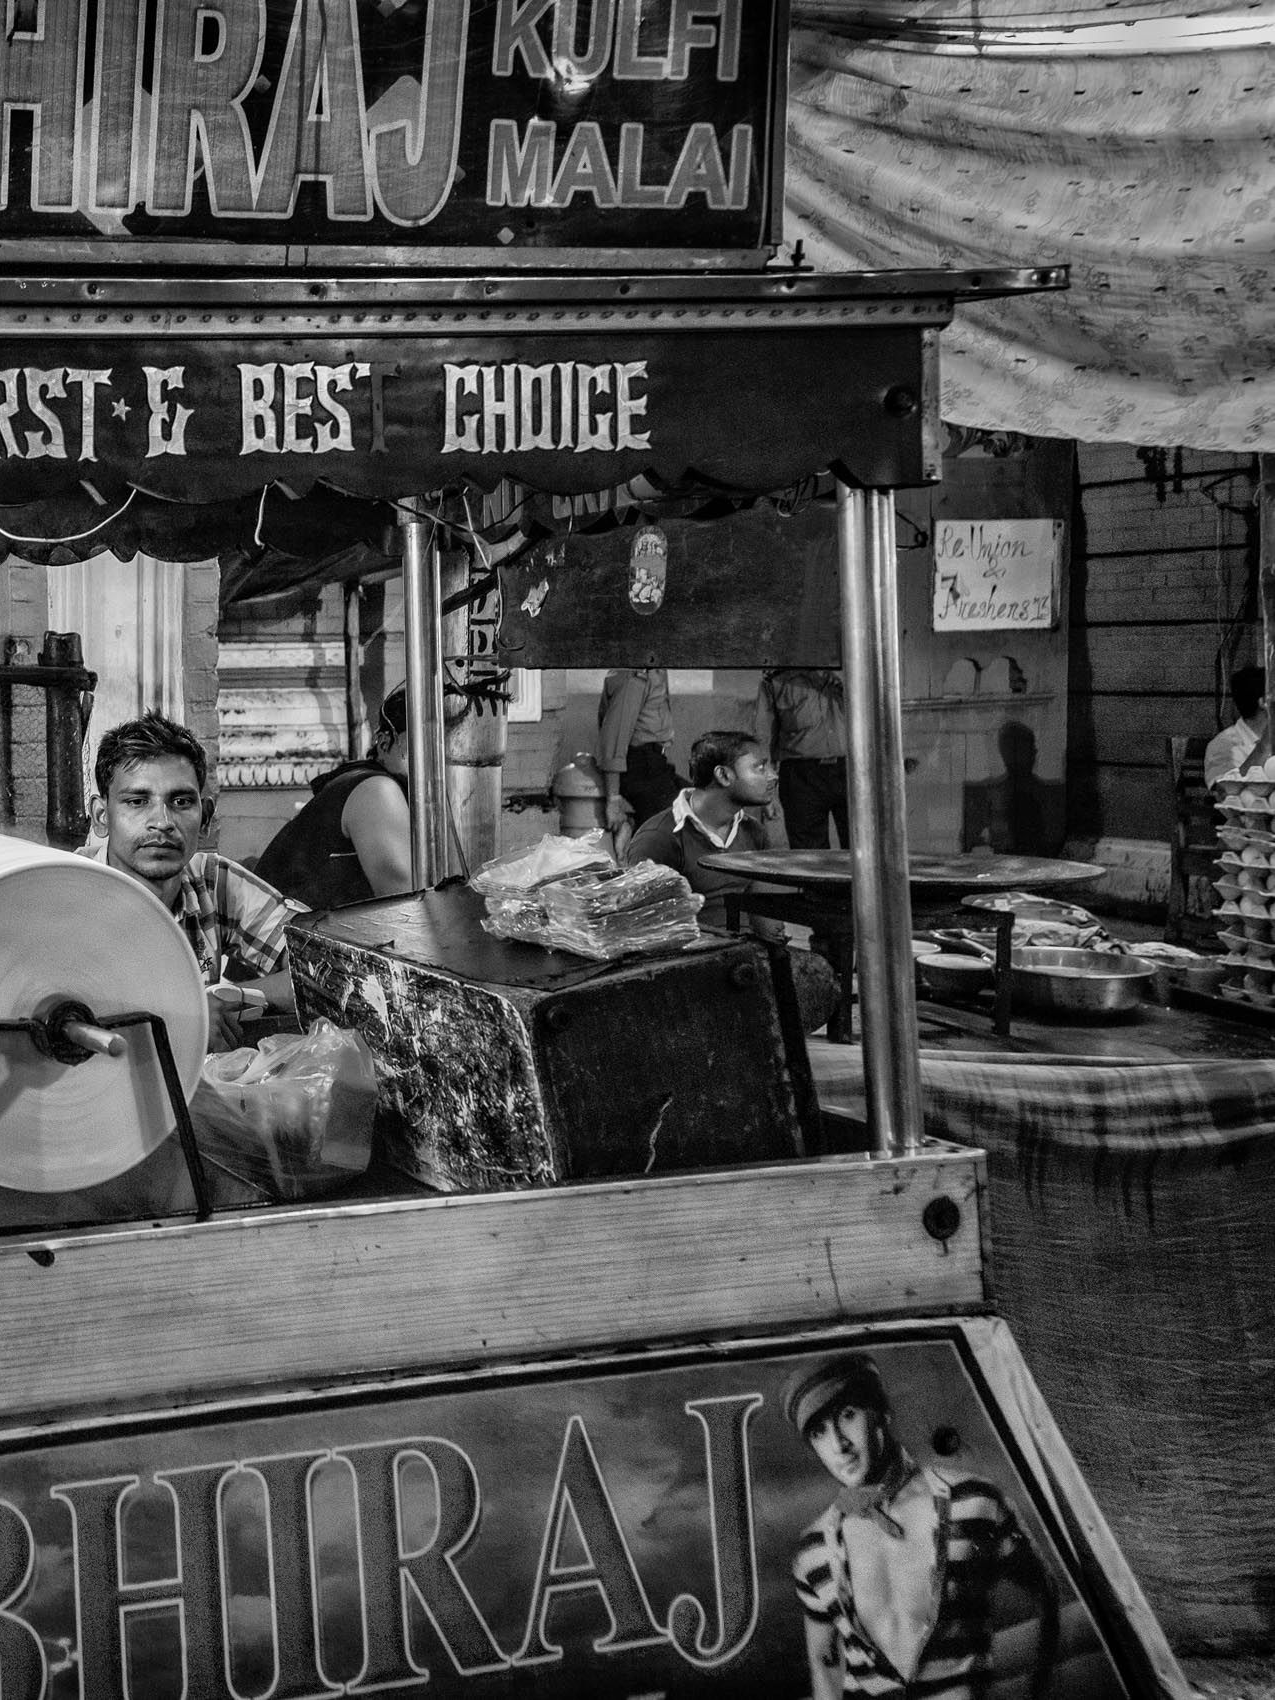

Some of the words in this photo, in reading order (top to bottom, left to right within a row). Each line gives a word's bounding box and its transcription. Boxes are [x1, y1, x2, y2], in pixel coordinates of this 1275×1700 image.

[492, 0, 740, 84] KULFI
[486, 118, 752, 210] MALAI
[441, 360, 653, 455] CHOICE
